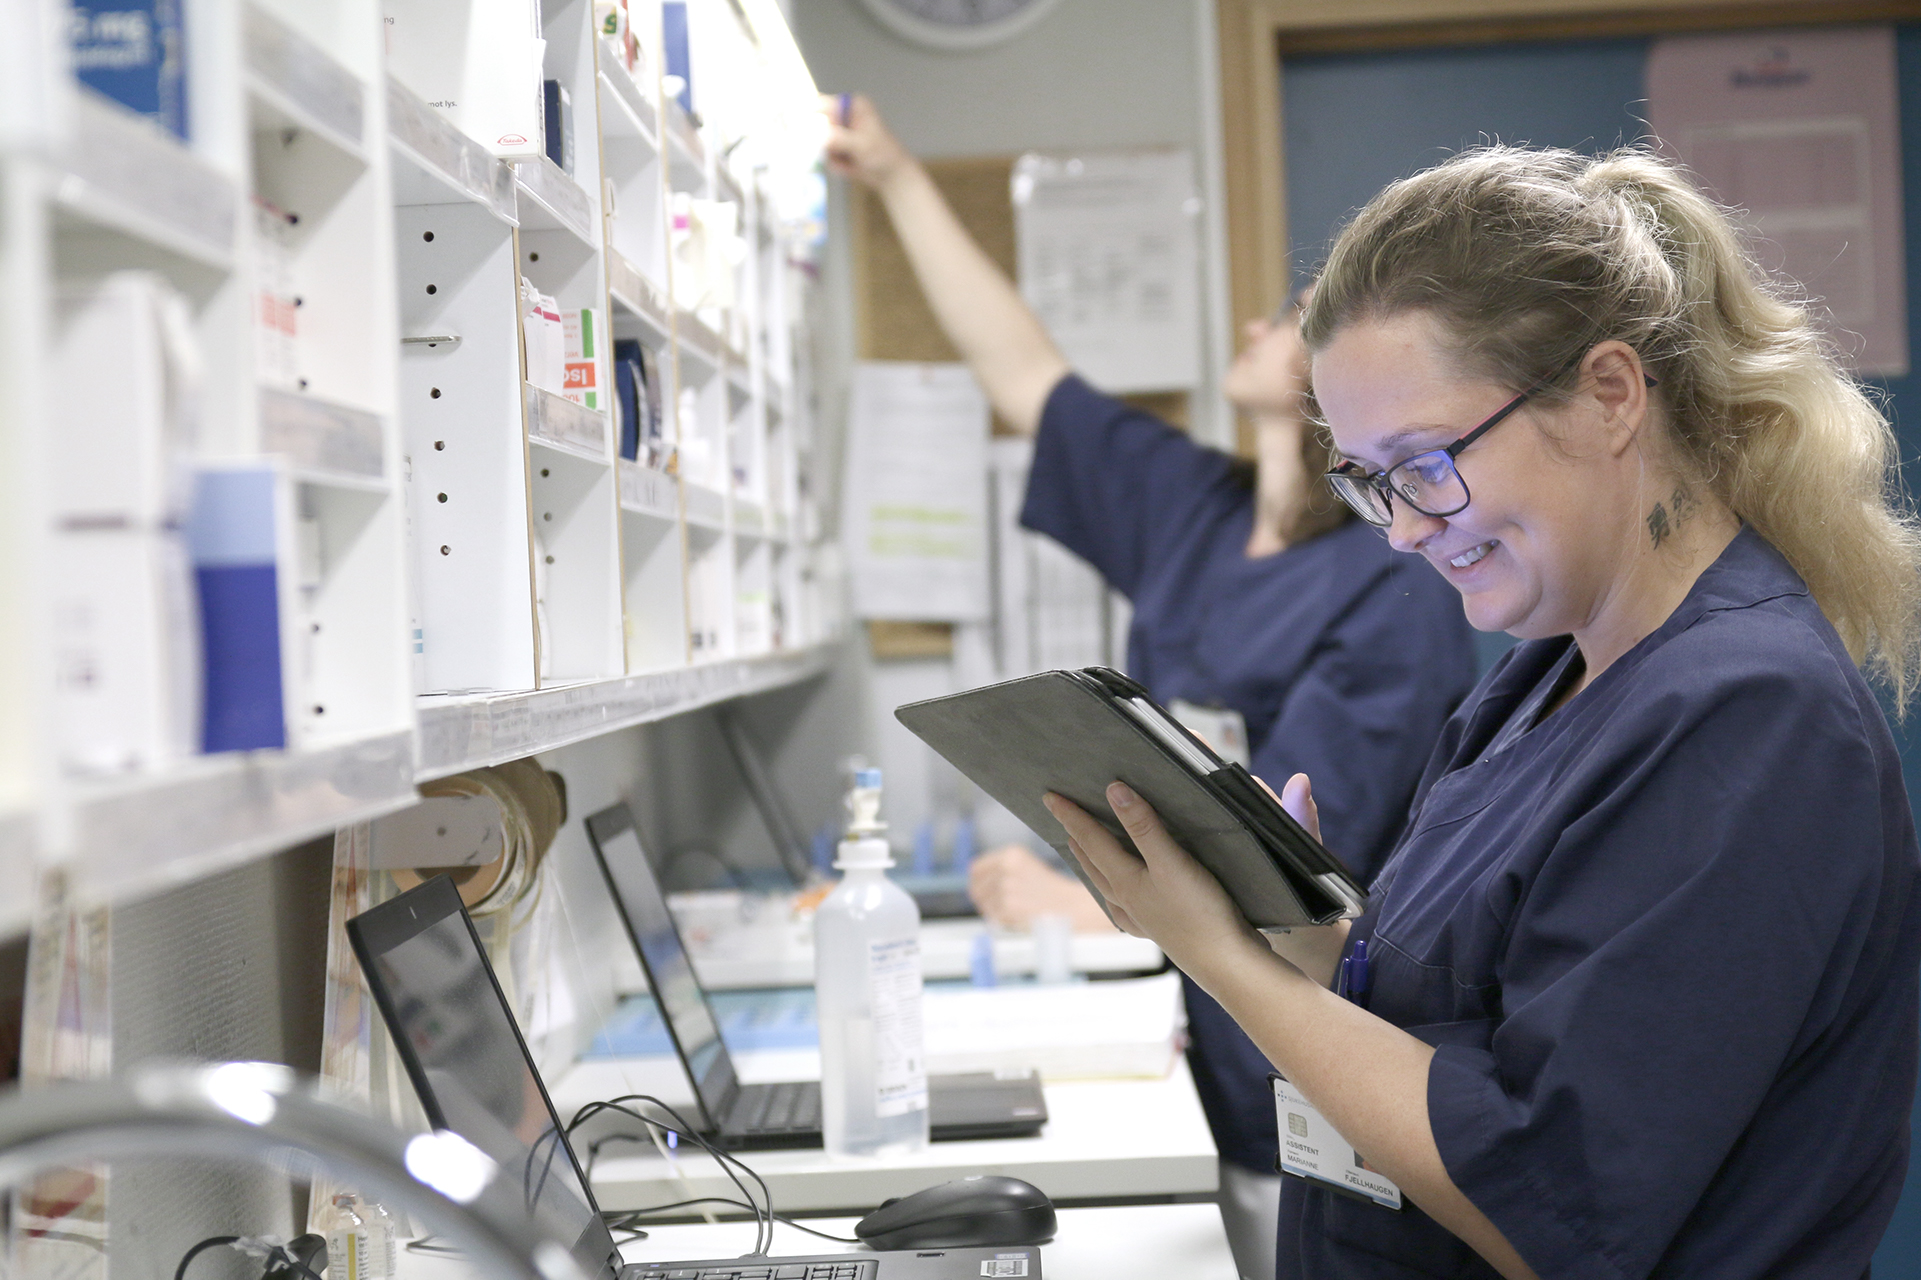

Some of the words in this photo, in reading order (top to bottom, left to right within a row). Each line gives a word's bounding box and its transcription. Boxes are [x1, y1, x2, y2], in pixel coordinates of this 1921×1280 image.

[445, 100, 457, 109] lys.
[1286, 1140, 1319, 1156] ASSISTENT
[1287, 1154, 1319, 1171] MARIANNE
[1345, 1174, 1394, 1197] FJELLHAUGEN
